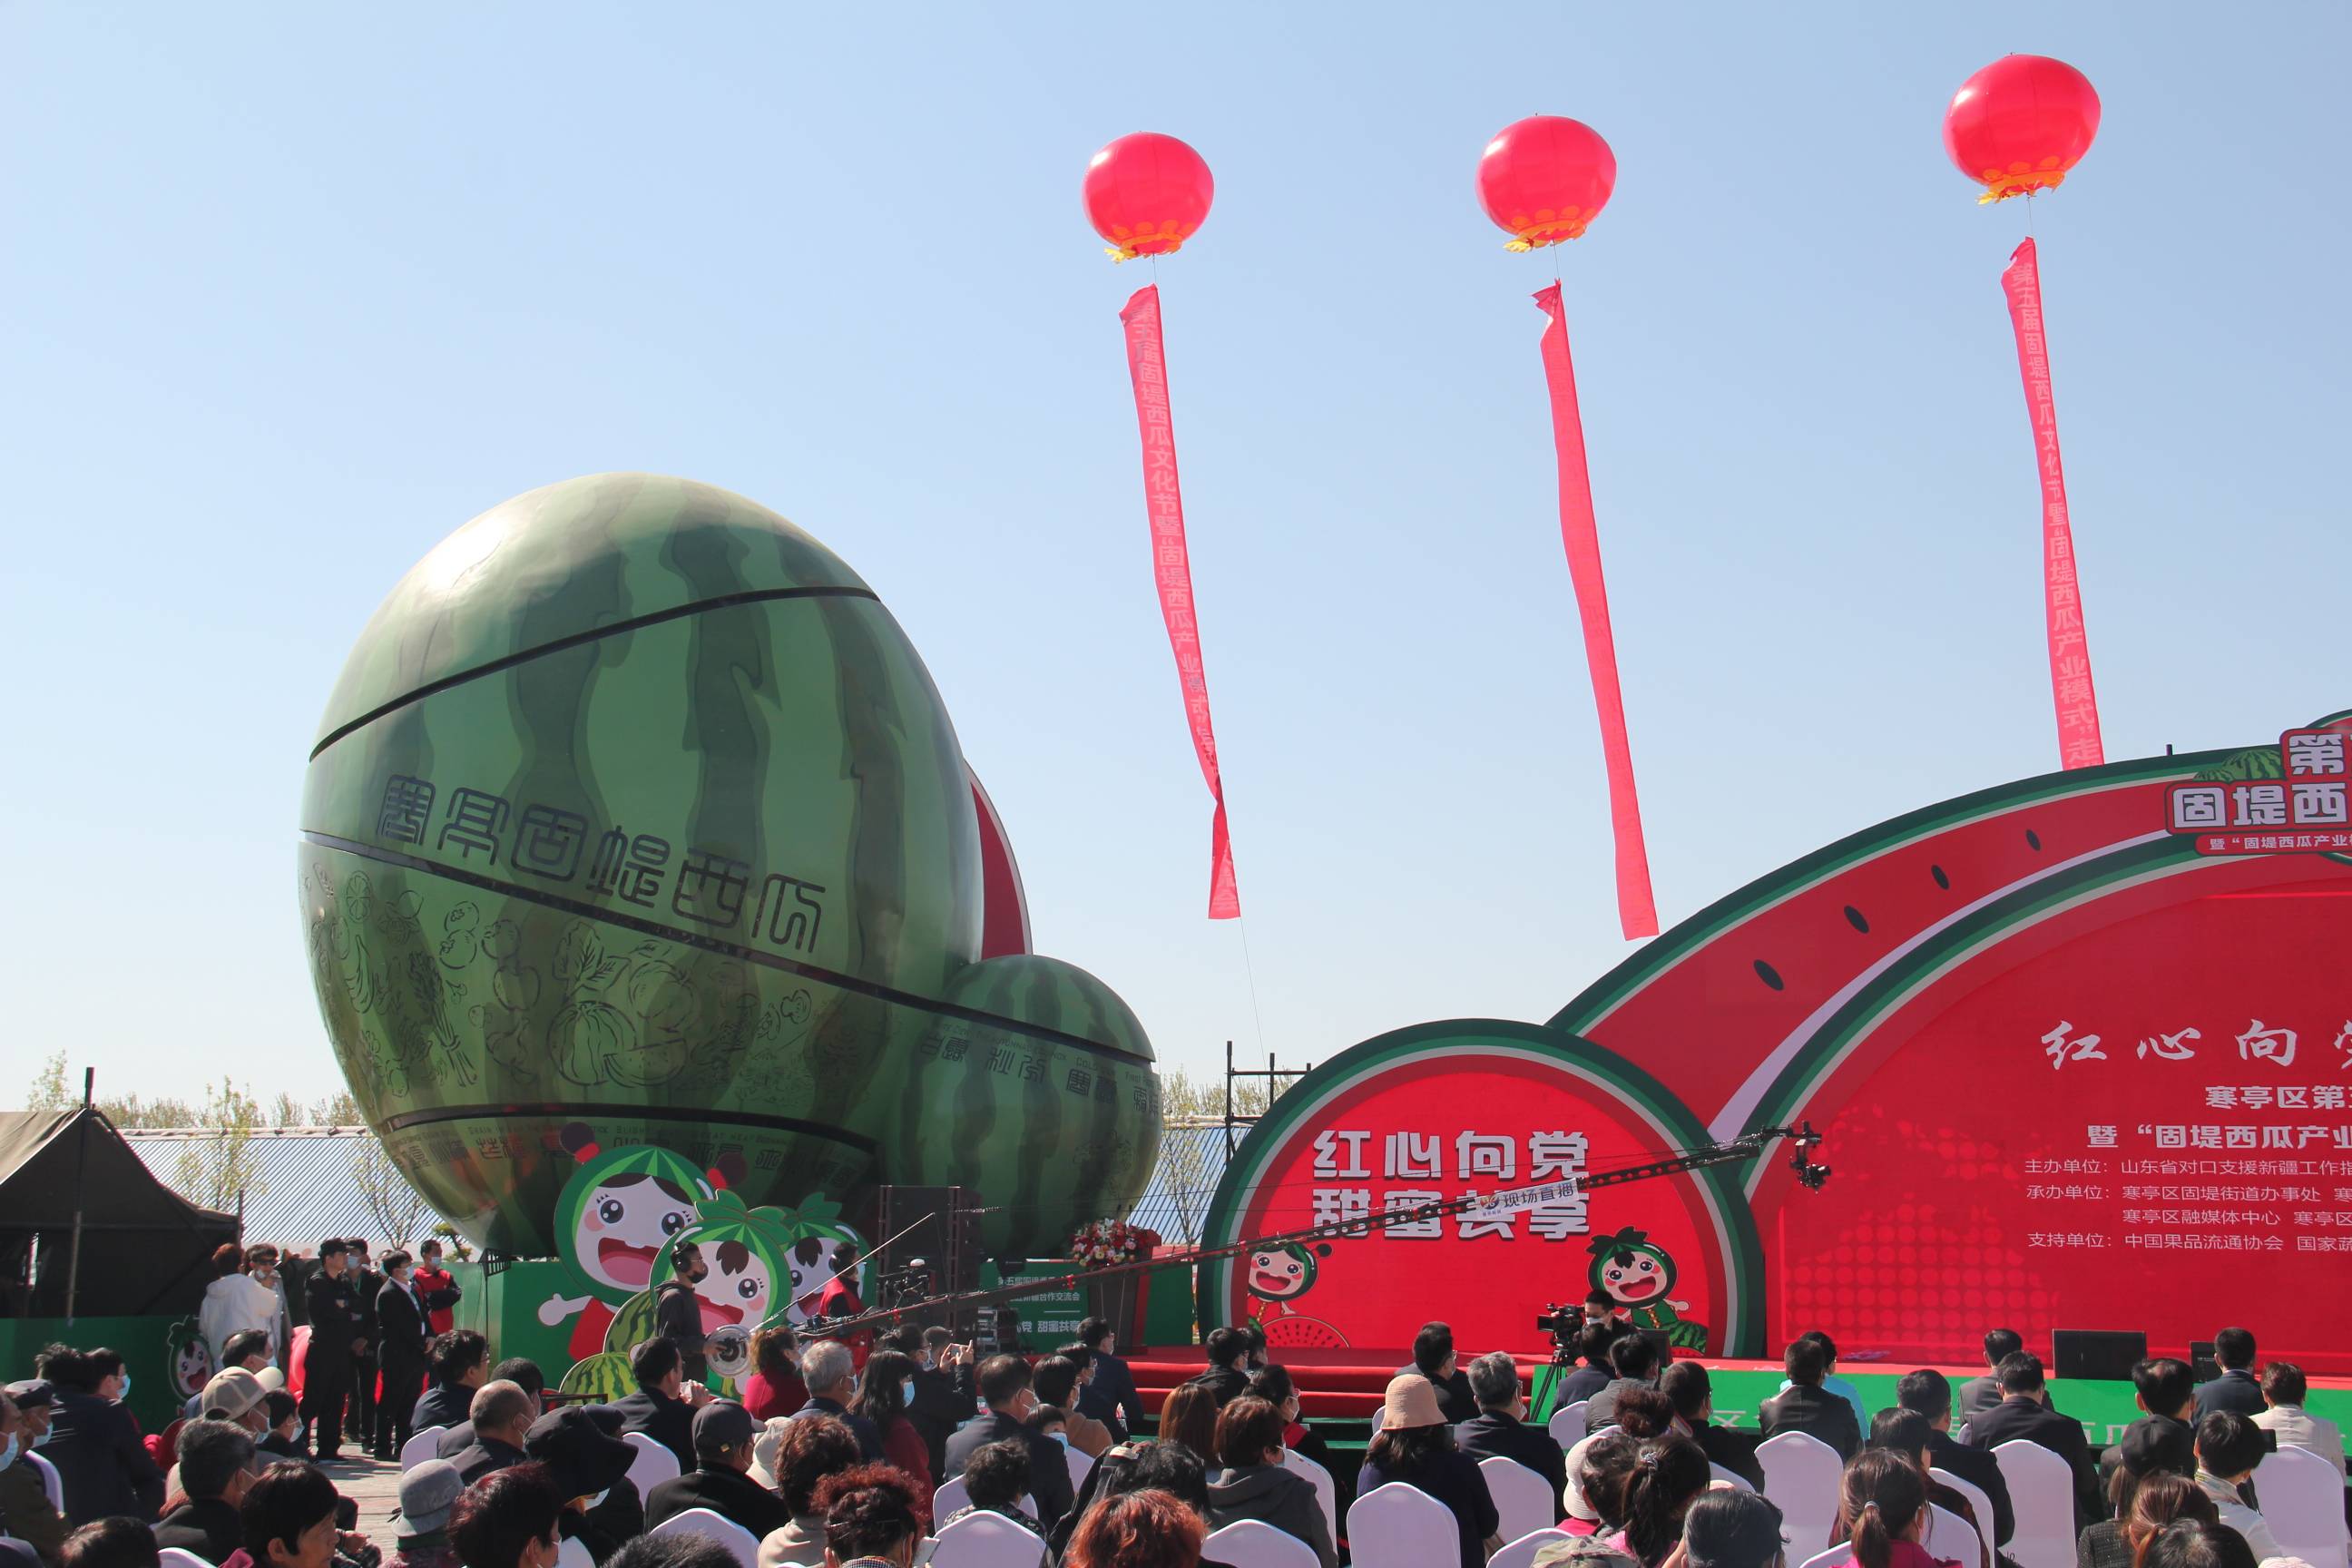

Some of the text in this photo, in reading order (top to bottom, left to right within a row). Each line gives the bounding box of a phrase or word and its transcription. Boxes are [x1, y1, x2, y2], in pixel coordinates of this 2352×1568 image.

[2288, 733, 2352, 776] 第
[2171, 781, 2347, 828] 固堤西
[2209, 834, 2352, 851] 暨“固堤西瓜产业
[2205, 1085, 2352, 1111] 寒亭区第
[1312, 1129, 1590, 1180] 红心向党
[1504, 1181, 1574, 1208] 现场直播
[2122, 1209, 2352, 1227] 寒亭区融媒体中心 寒亭区
